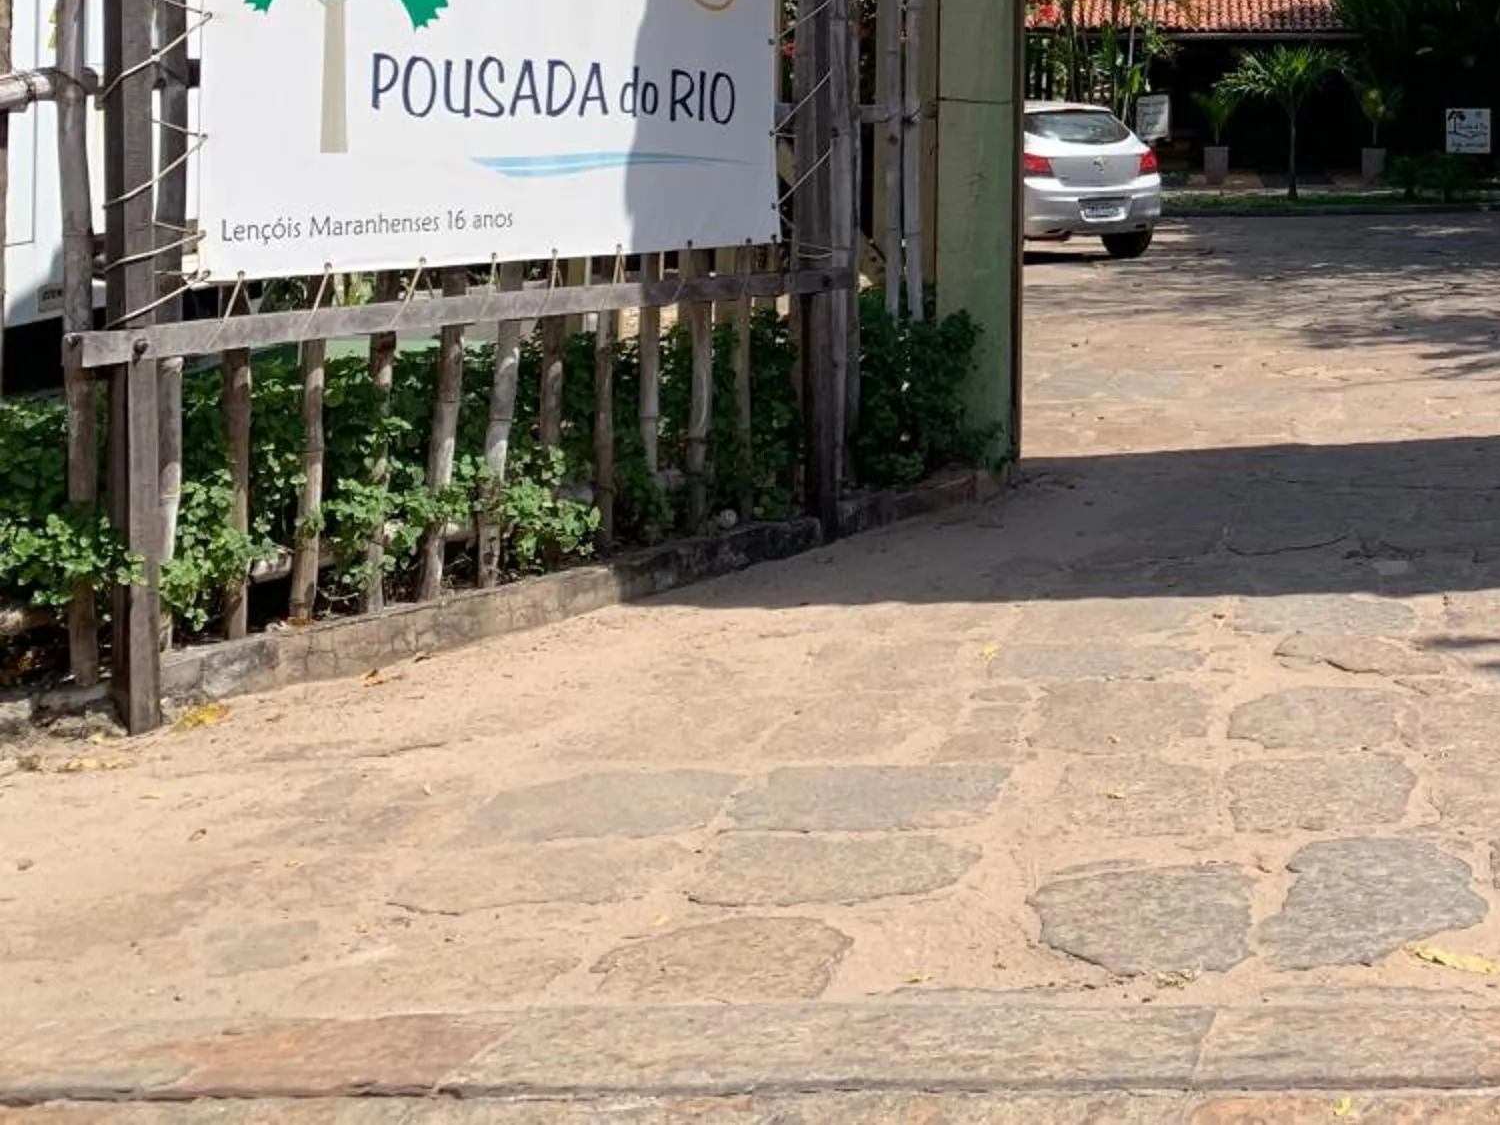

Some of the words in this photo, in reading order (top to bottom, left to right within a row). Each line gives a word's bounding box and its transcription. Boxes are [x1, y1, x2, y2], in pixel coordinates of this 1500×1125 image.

[371, 52, 609, 118] POUSADA
[619, 65, 659, 118] do
[669, 68, 736, 125] RIO
[220, 215, 302, 244] Lençóis
[309, 213, 440, 238] Maranhenses
[447, 209, 467, 231] 16
[472, 211, 514, 229] anos
